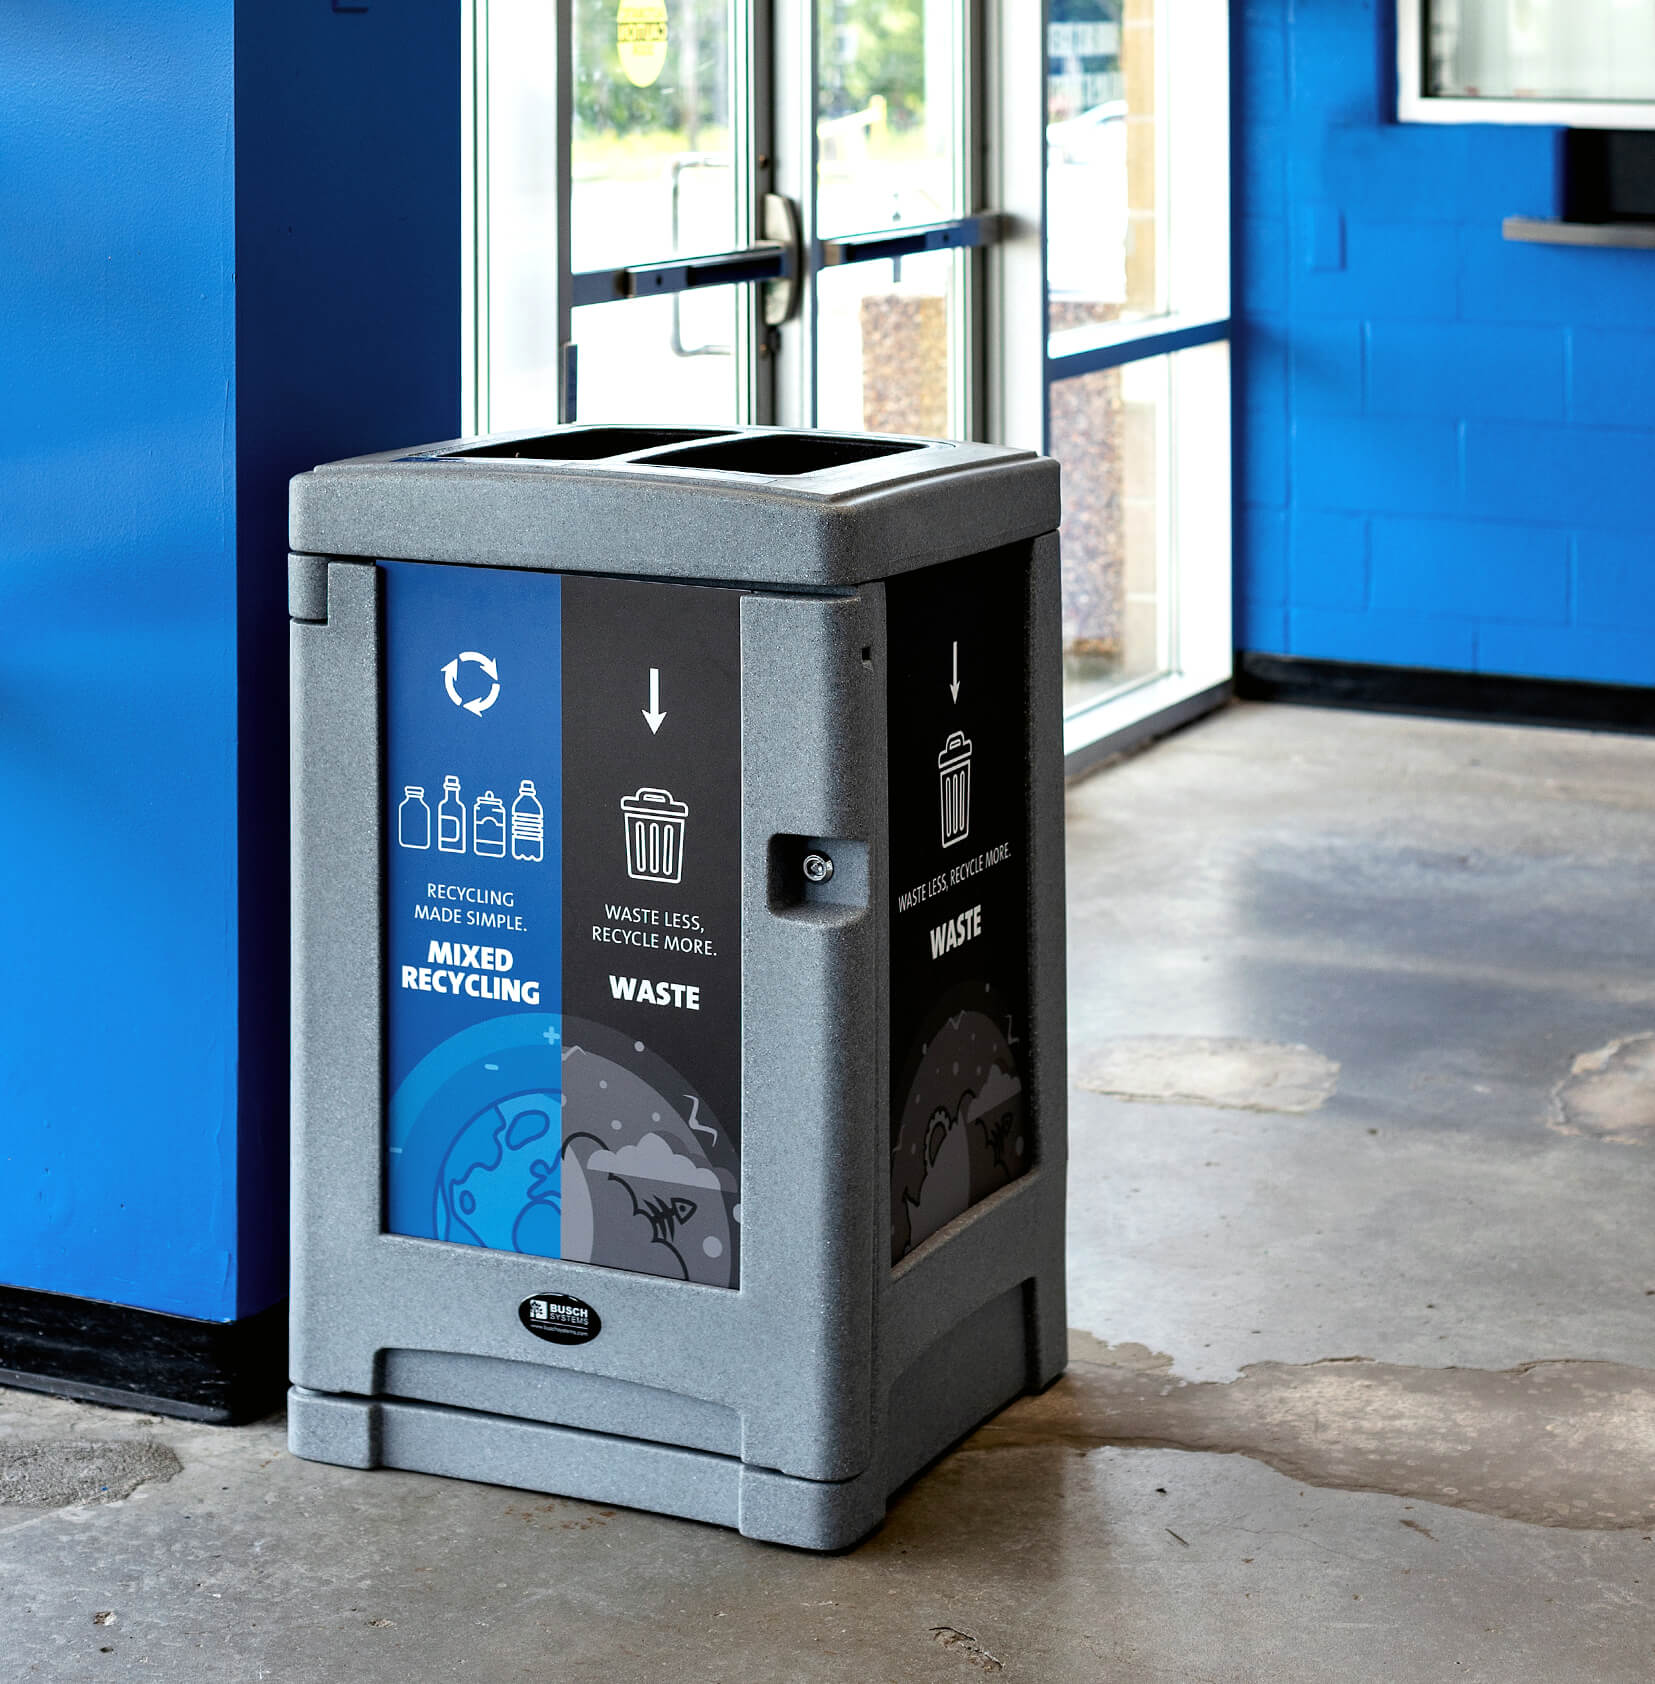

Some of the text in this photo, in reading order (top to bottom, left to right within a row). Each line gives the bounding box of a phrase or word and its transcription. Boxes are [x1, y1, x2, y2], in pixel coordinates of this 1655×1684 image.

[898, 842, 1012, 913] WASTE LESS, RECYCLE MORE.
[427, 882, 514, 908] RECYCLING
[414, 904, 528, 932] MADE SIMPLE.
[605, 903, 705, 934] WASTE LESS,
[929, 904, 982, 960] WASTE
[427, 940, 514, 972] MIXED
[592, 925, 718, 957] RECYCLE MORE.
[401, 965, 540, 1005] RECYCLING
[608, 974, 700, 1011] WASTE
[549, 1303, 588, 1318] BUSCH
[549, 1312, 589, 1325] SYSTEMS
